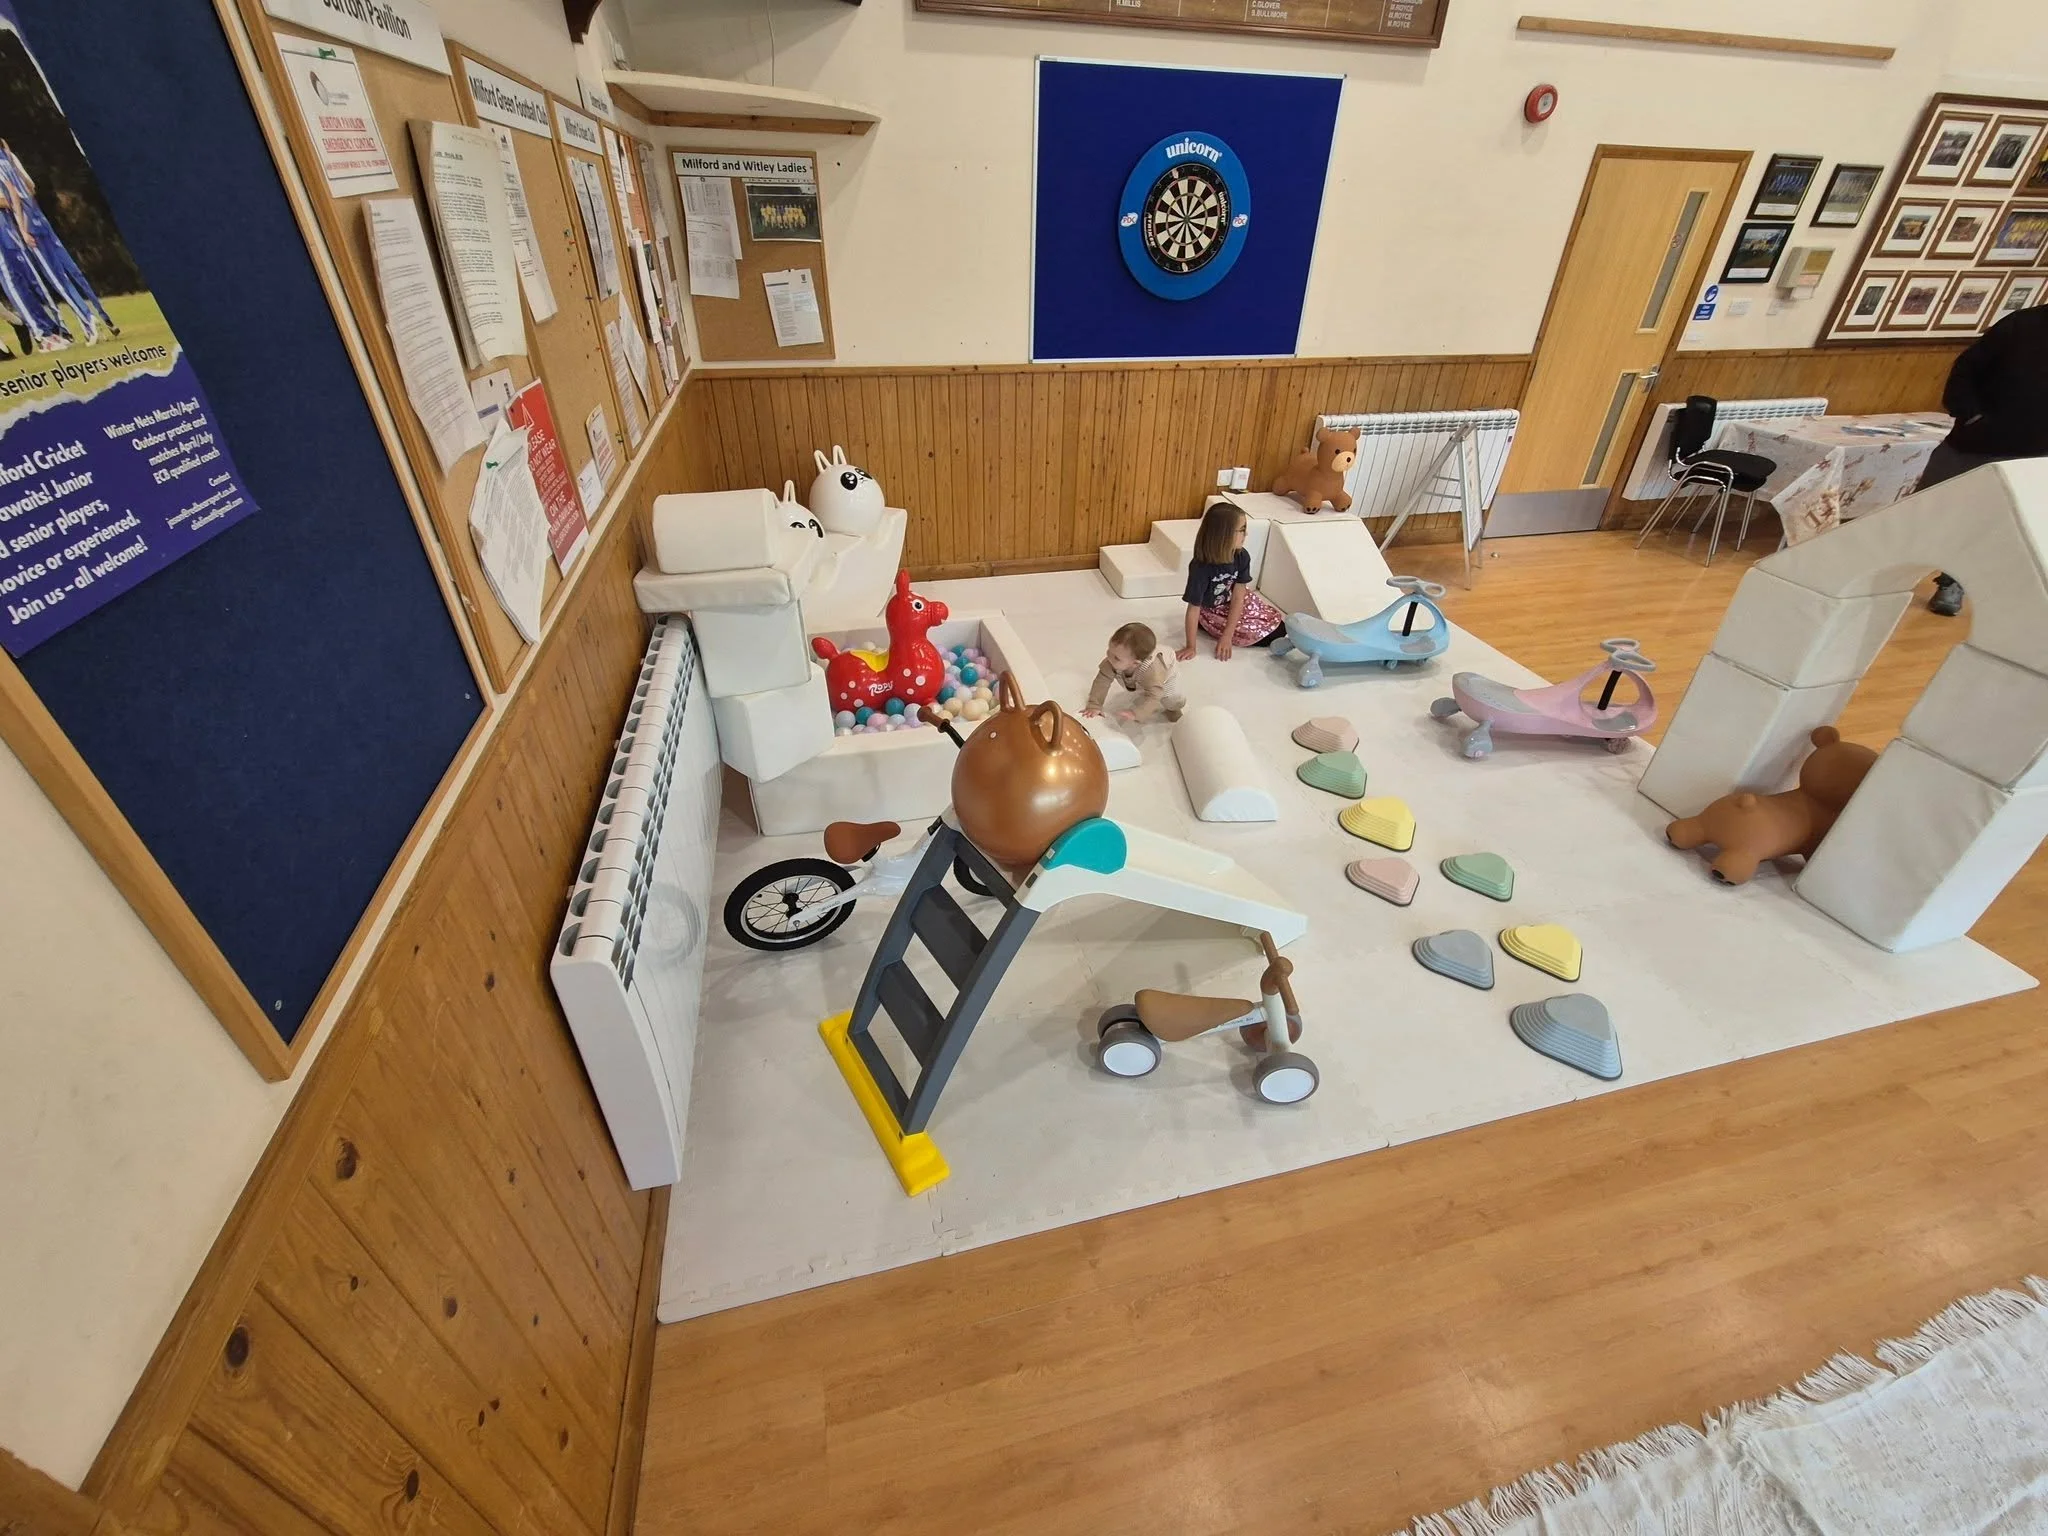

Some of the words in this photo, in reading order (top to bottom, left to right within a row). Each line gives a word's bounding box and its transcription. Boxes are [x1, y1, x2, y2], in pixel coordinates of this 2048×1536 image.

[364, 3, 413, 41] Pavilion
[469, 75, 498, 108] Milford
[495, 87, 517, 114] Green
[514, 95, 540, 122] Football
[682, 158, 720, 170] Milford
[722, 161, 740, 170] and
[742, 162, 775, 174] Witley
[777, 163, 807, 173] Ladies
[1165, 137, 1220, 163] unicorn
[0, 370, 49, 397] senior
[51, 360, 109, 388] players
[107, 345, 167, 366] welcome
[103, 422, 136, 439] Winter
[133, 415, 156, 429] Nets
[153, 396, 200, 423] March/April
[33, 440, 88, 470] Cricket
[132, 433, 167, 451] Outdoor
[149, 448, 180, 466] matches
[153, 468, 171, 484] ECB
[0, 483, 54, 522] awaits!
[50, 472, 94, 498] Junior
[10, 523, 56, 552] senior
[55, 499, 110, 535] players,
[46, 552, 63, 570] or
[63, 509, 142, 560] experienced.
[7, 597, 46, 625] Join
[44, 587, 65, 604] us
[74, 565, 95, 589] all
[91, 535, 149, 578] welcome!
